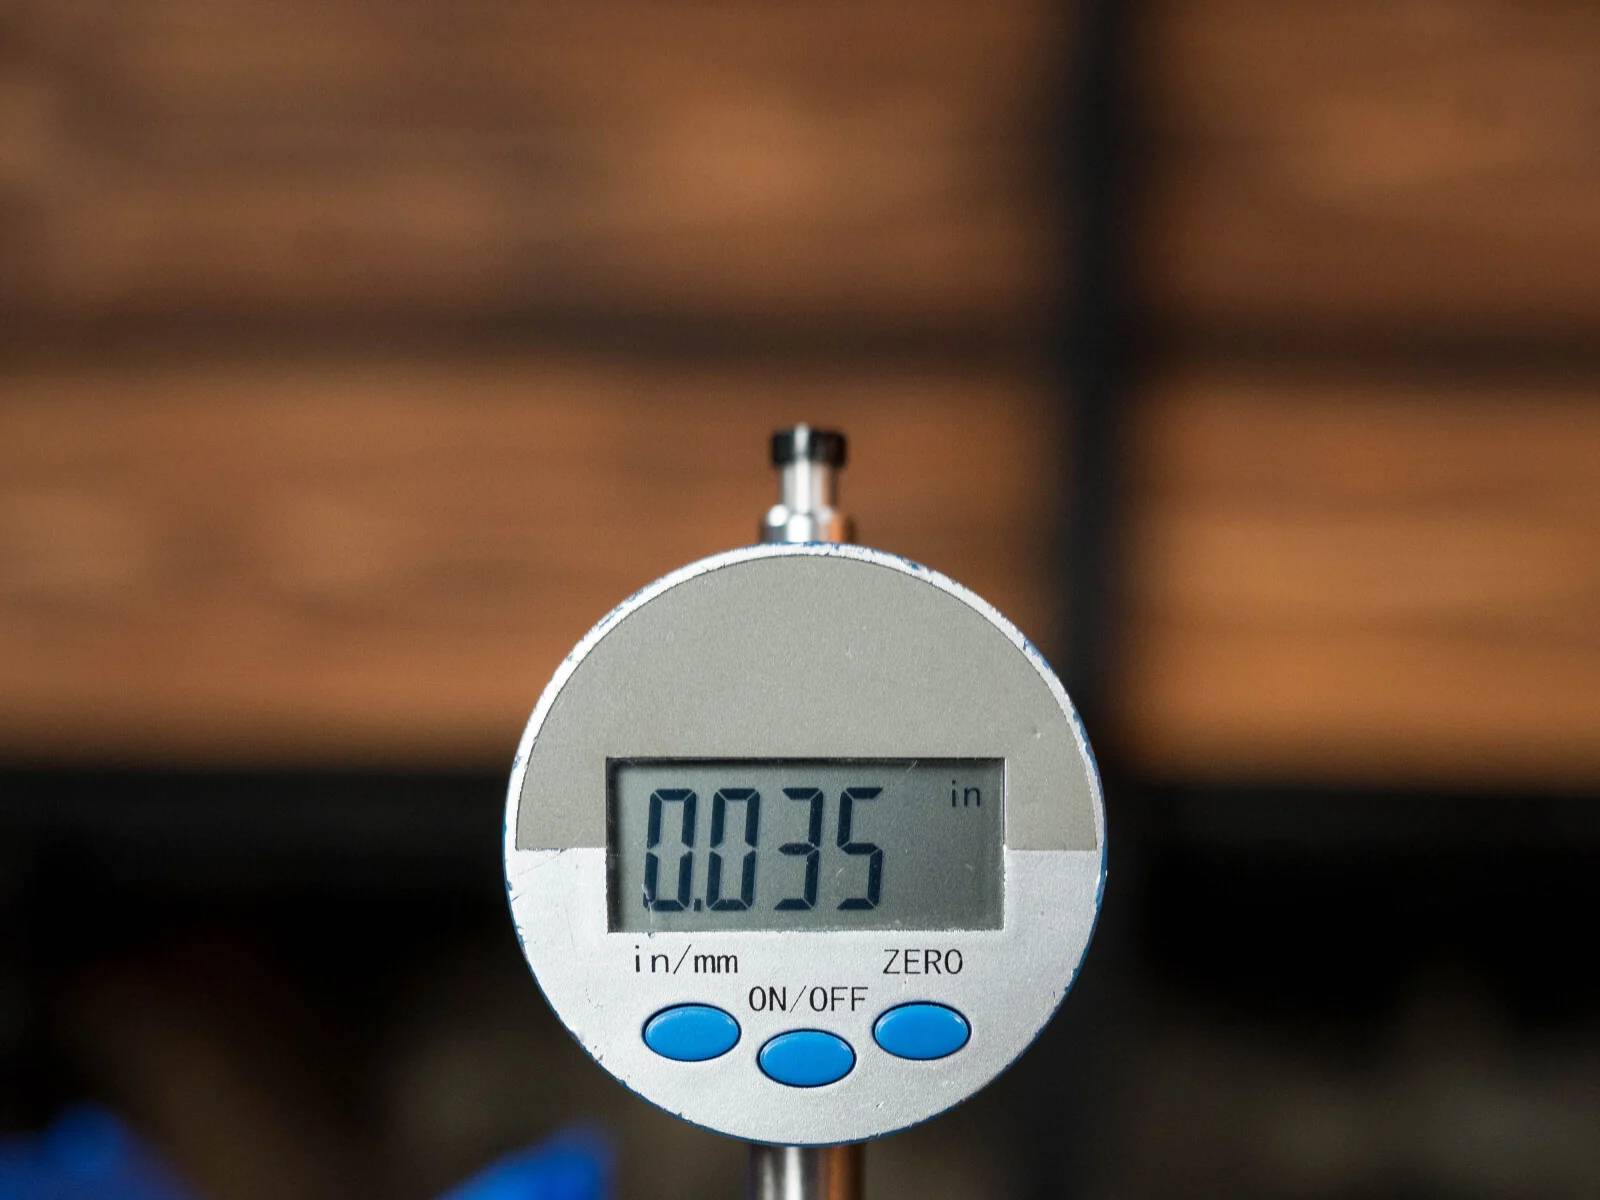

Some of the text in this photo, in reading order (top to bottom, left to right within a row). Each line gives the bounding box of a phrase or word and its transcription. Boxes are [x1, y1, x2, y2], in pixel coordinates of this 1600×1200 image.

[643, 780, 982, 912] 0.035 in
[634, 944, 964, 975] in/mm ZERO
[748, 985, 869, 1013] ON/OFF
